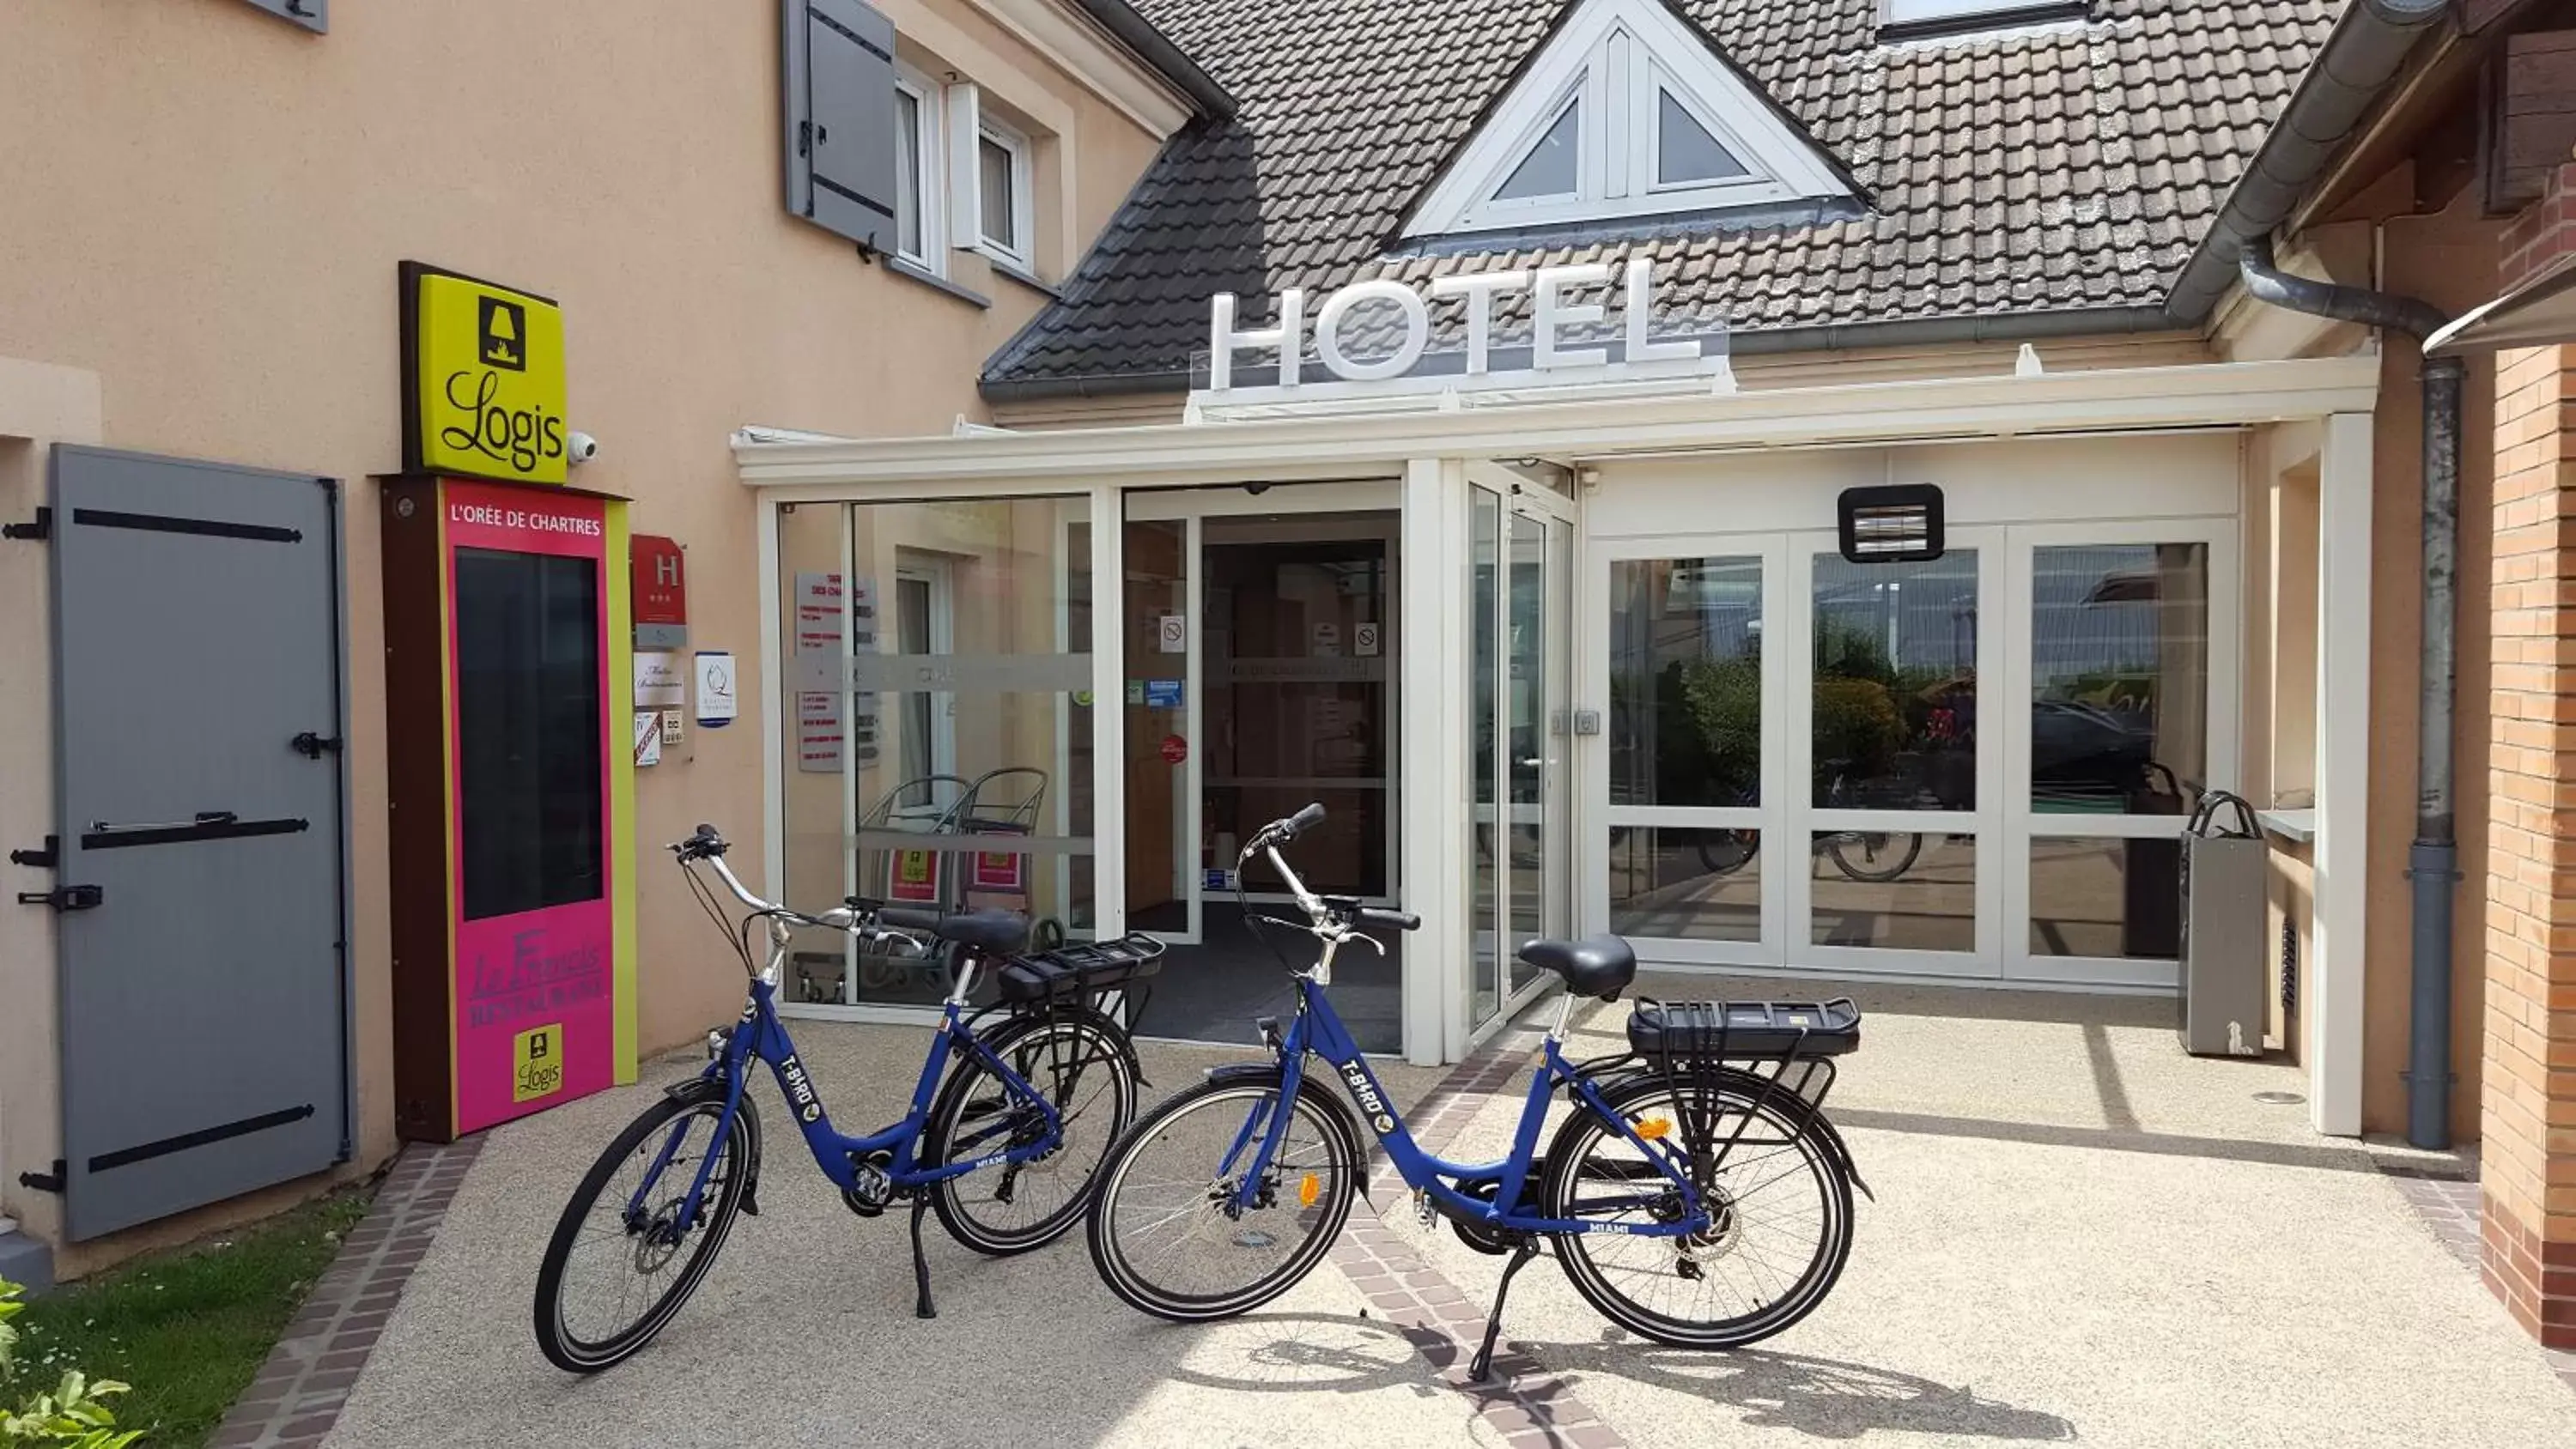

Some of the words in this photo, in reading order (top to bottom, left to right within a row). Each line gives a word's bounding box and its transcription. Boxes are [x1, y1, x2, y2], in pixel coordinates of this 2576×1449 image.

[1210, 259, 1701, 391] HOTEL
[441, 370, 563, 472] Logis
[450, 505, 502, 526] L'ORÉE
[507, 511, 526, 529] DE
[529, 513, 601, 537] CHARTRES
[656, 554, 678, 587] H
[518, 1060, 560, 1093] Logis
[781, 1055, 813, 1104] T-BIRD
[1341, 1059, 1383, 1113] T-BIRD
[975, 1155, 1007, 1168] MIAMI
[1589, 1222, 1630, 1234] MIAMI
